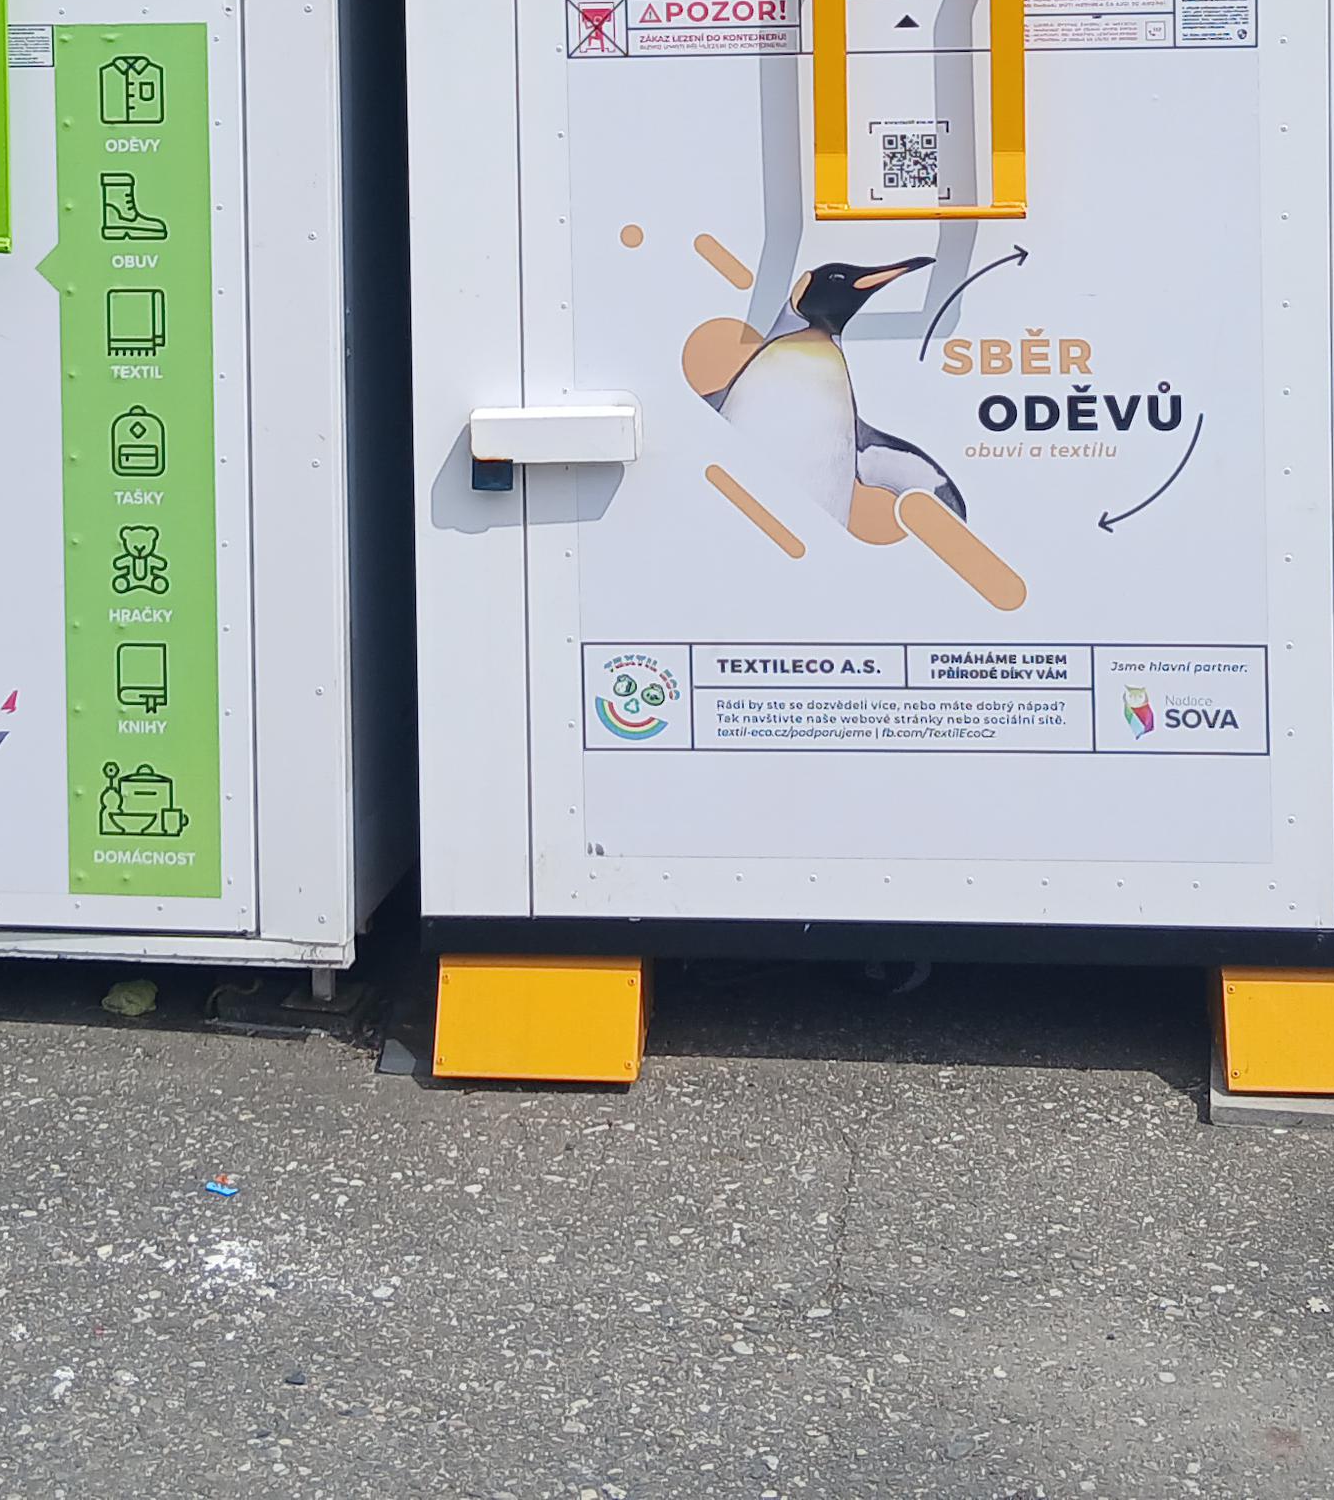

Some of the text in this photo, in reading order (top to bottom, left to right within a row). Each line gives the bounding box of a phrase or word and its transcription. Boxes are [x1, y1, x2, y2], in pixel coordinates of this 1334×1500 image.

[666, 0, 787, 23] POZOR!
[105, 137, 161, 153] ODĚVY
[111, 254, 159, 269] OBUV
[941, 328, 1093, 375] SBĚR
[110, 365, 163, 380] TEXTIL
[978, 380, 1182, 432] ODĚVŮ
[965, 441, 1117, 458] obuvi a textilu
[114, 489, 165, 505] TAŠKY
[109, 607, 173, 623] HRAČKY
[717, 658, 881, 674] TEXTILECO A.S.
[930, 651, 1067, 665] POMÁHÁME LIDEM
[1036, 667, 1067, 680] VÁM
[1149, 661, 1191, 672] hlavní
[717, 699, 745, 710] Rádi
[748, 699, 764, 712] by
[904, 700, 936, 711] nebo
[976, 700, 1014, 713] dobrý
[1018, 700, 1066, 713] nápad?
[1165, 695, 1213, 707] Nadace
[947, 714, 980, 725] nebo
[1164, 708, 1240, 729] SOVA
[118, 720, 168, 734] KNIHY
[94, 847, 196, 865] DOMÁCNOST
